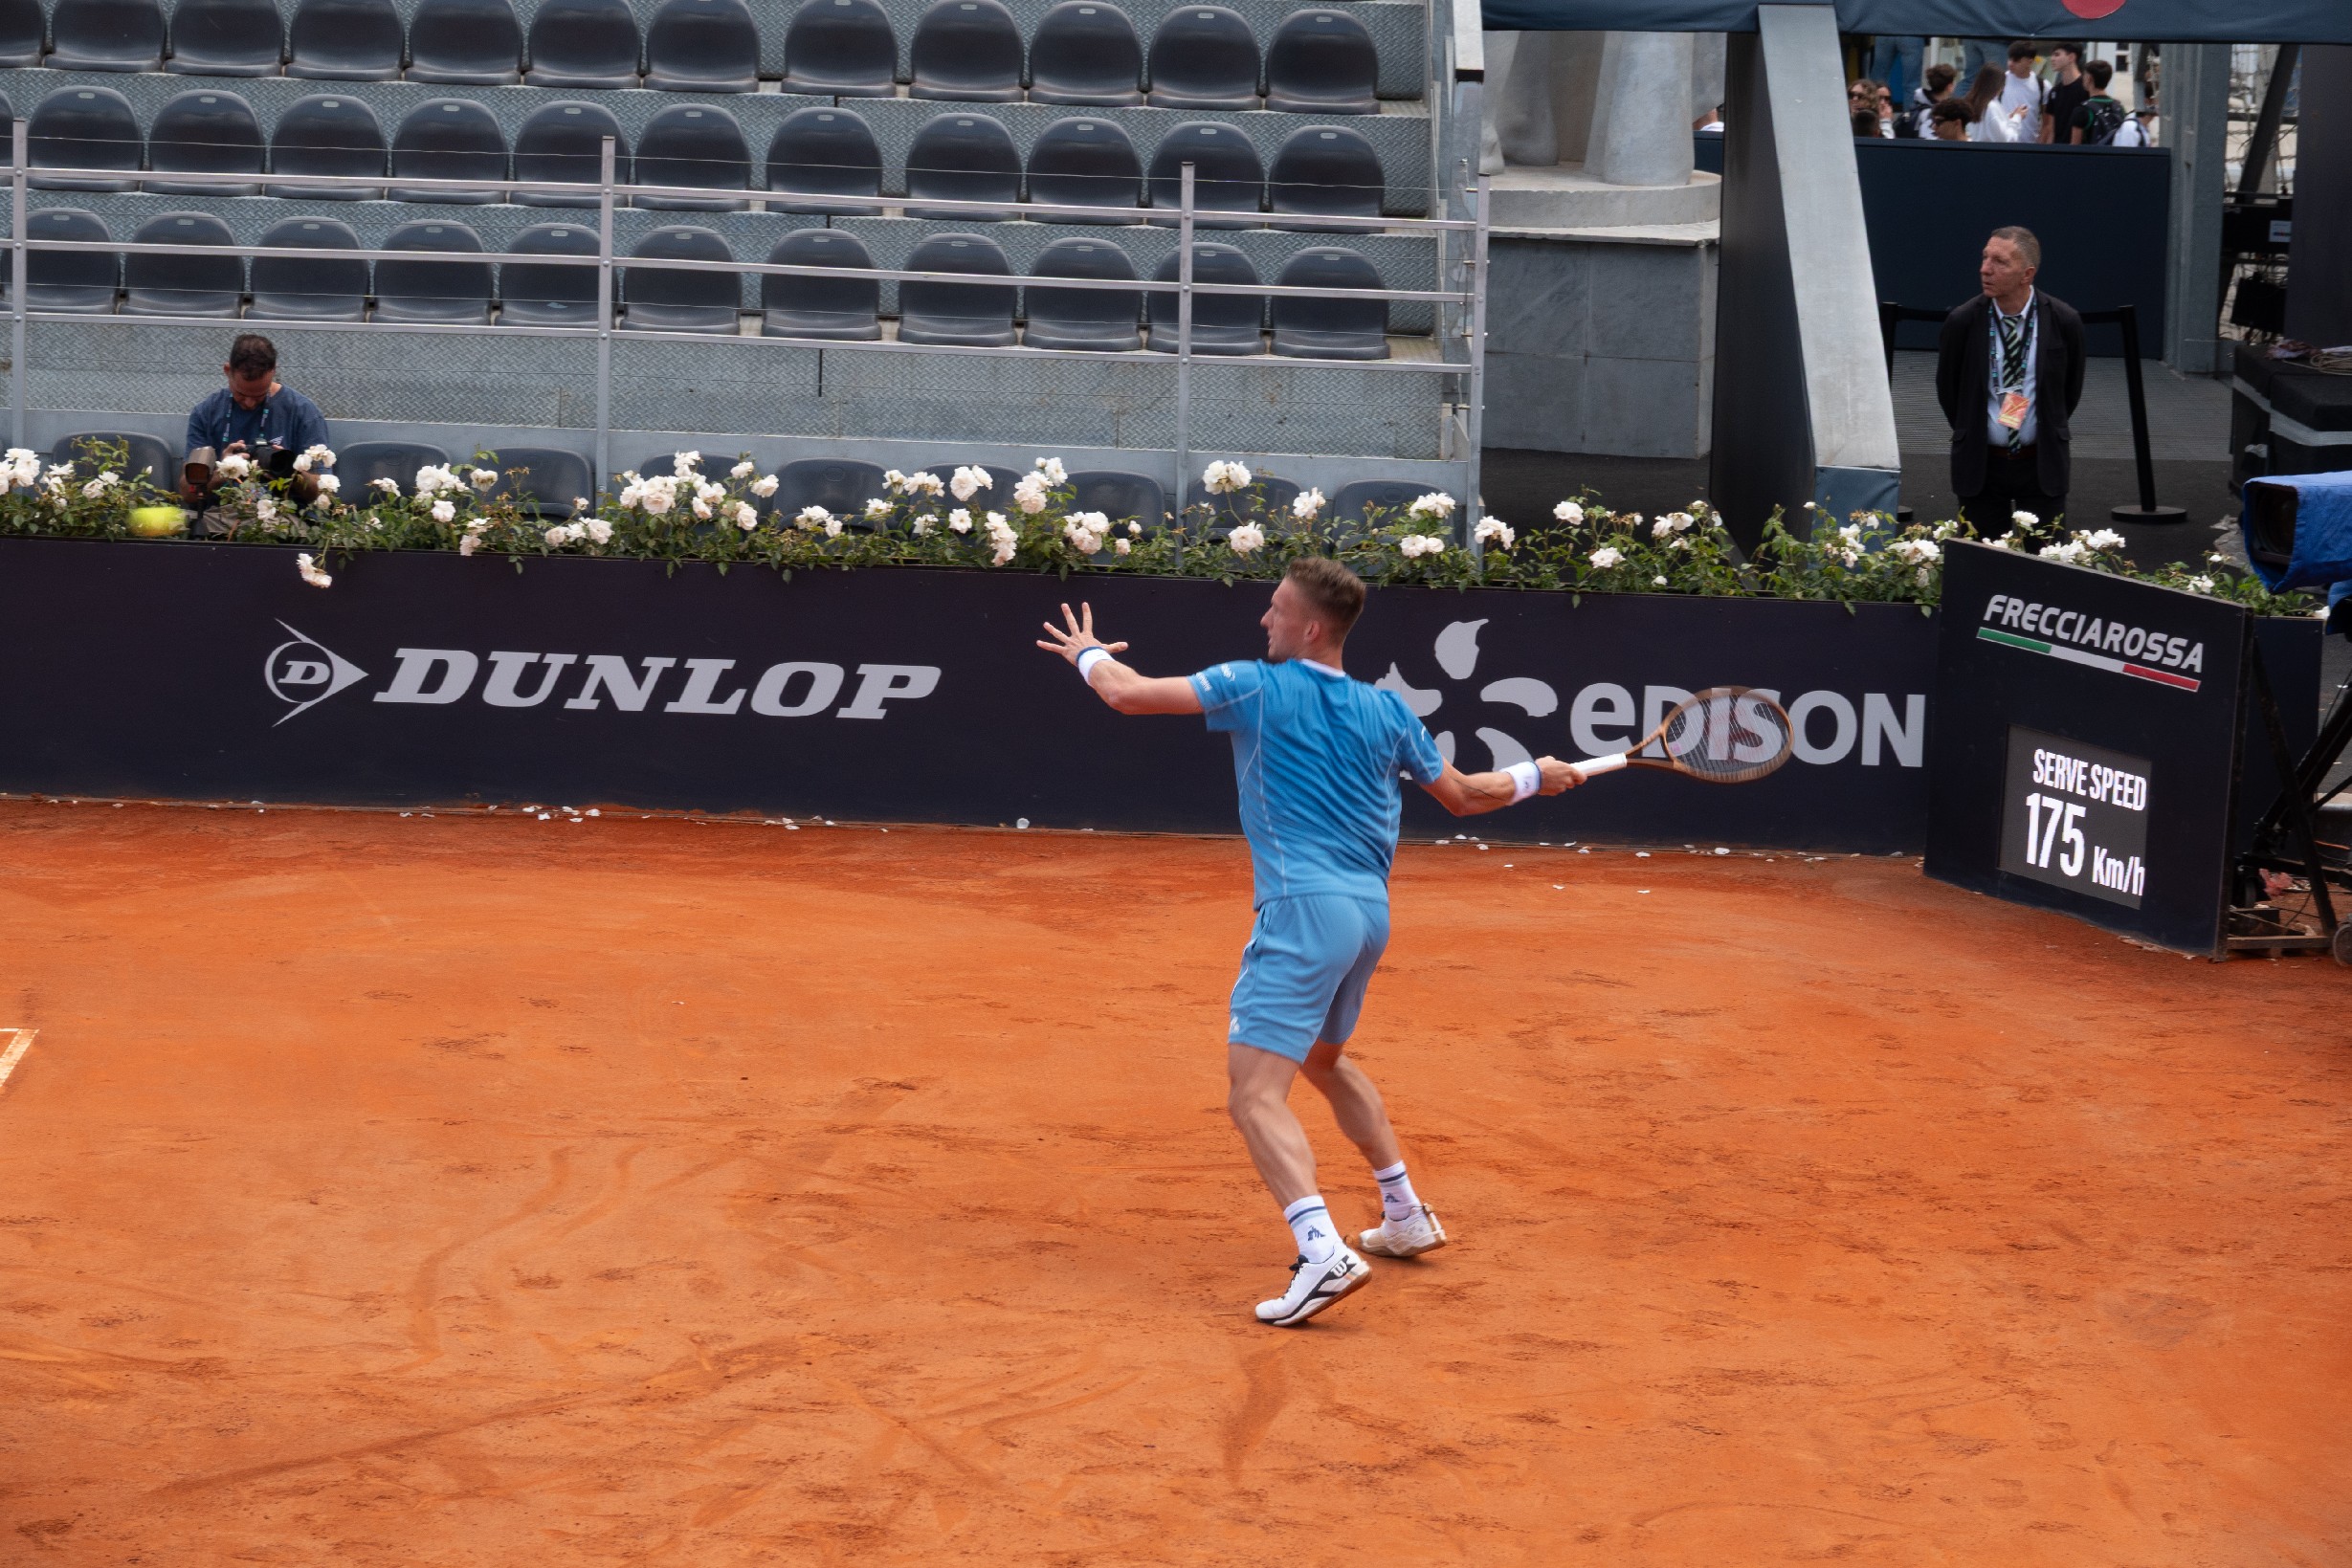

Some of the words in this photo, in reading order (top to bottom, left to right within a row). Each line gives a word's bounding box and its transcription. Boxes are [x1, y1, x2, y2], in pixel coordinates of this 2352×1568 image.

[1983, 594, 2204, 674] FRECCIAROSSA
[277, 660, 330, 685] D
[372, 648, 942, 719] DUNLOP
[2032, 748, 2089, 796] SERVE
[2089, 763, 2147, 811] SPEED
[2026, 792, 2087, 877] 175
[2092, 845, 2146, 896] Km/h
